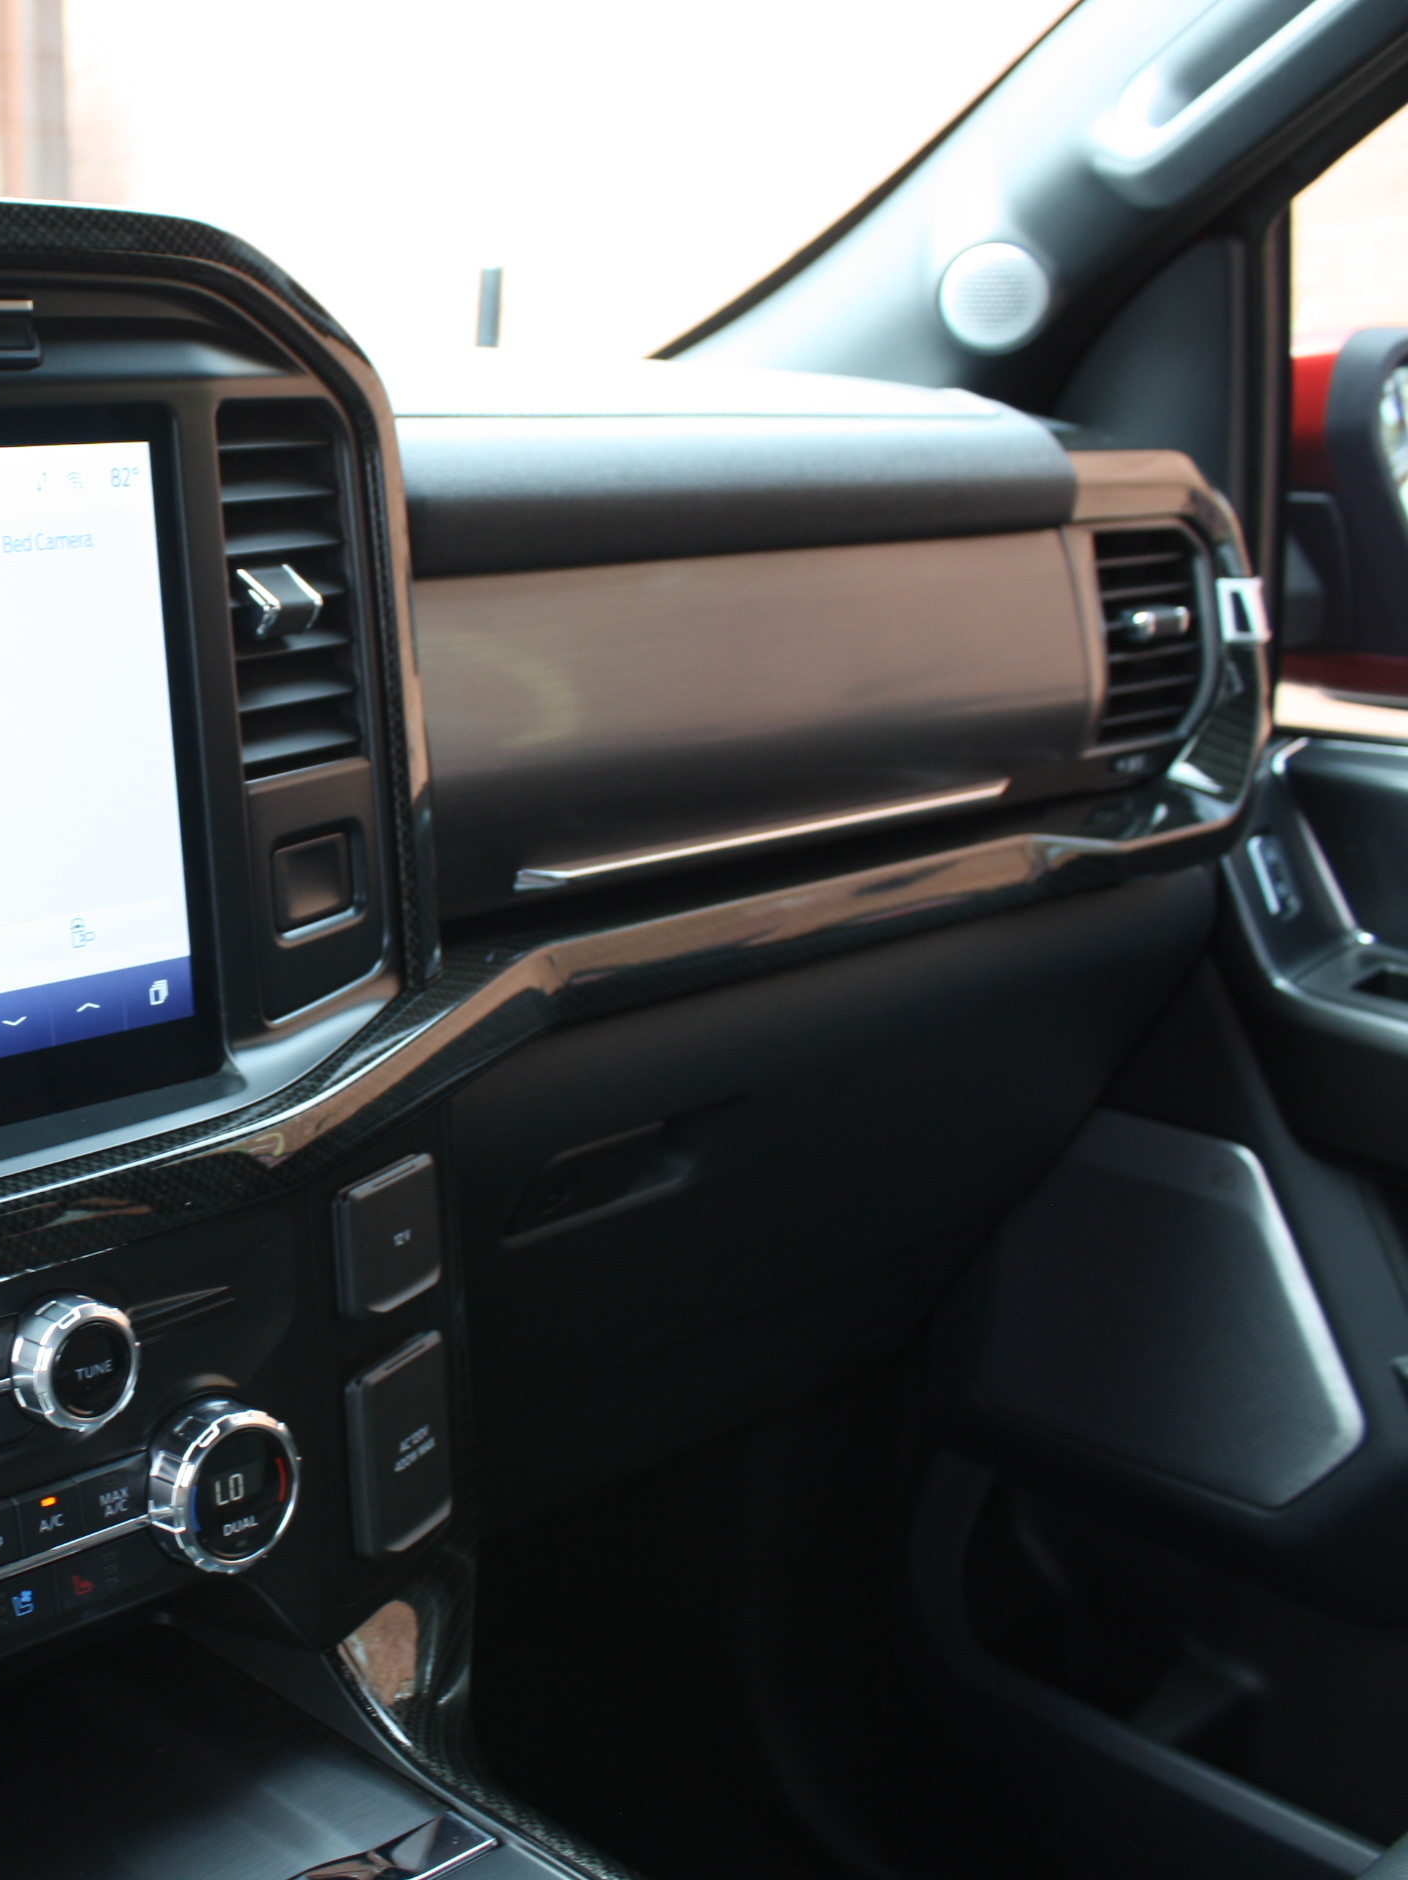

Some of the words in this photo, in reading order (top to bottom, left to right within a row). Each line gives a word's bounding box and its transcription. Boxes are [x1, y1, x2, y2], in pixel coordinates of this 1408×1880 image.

[1, 533, 32, 553] Bed
[34, 532, 94, 551] Camera
[74, 1358, 115, 1382] TUNE
[99, 1486, 130, 1506] MAX
[104, 1501, 128, 1518] A/C
[38, 1513, 65, 1533] A/C
[223, 1515, 259, 1536] DUAL
